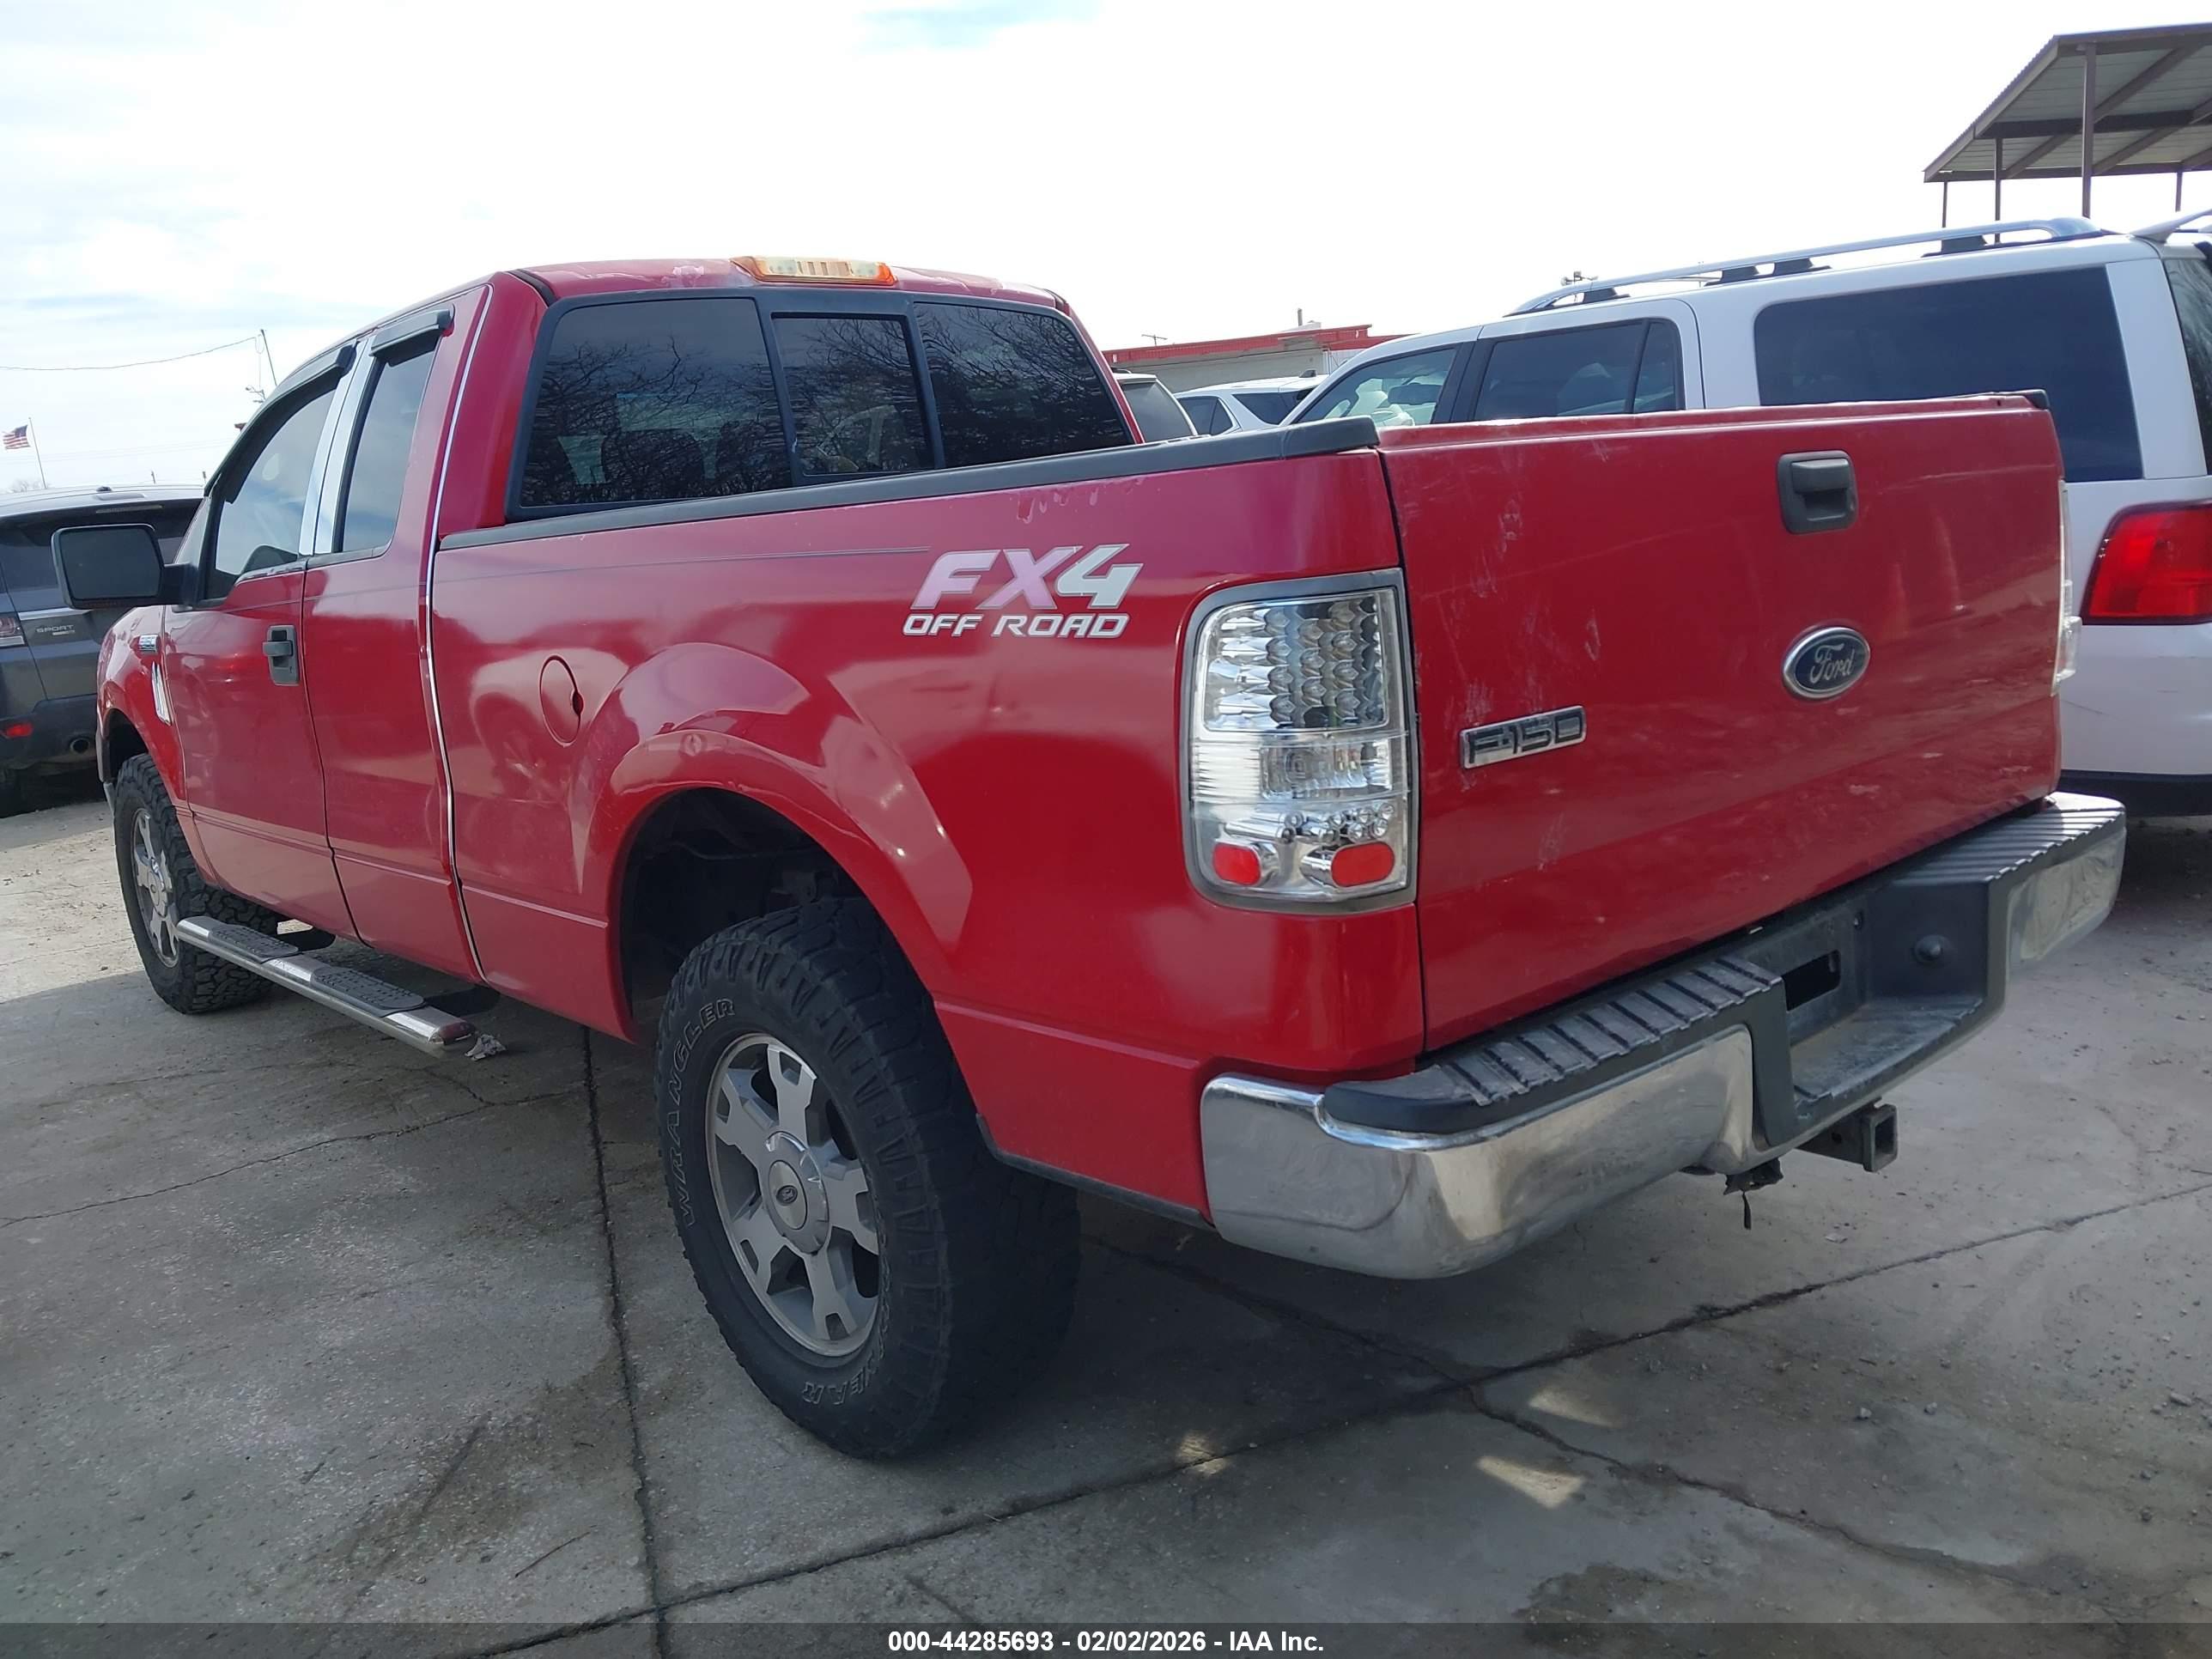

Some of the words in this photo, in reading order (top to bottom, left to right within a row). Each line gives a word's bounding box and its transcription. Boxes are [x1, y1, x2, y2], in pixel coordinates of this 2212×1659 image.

[908, 544, 1144, 610] FX4
[902, 614, 983, 637] OFF
[991, 614, 1130, 638] ROAD
[1809, 642, 1856, 684] Ford
[667, 999, 735, 1226] WRANGLER
